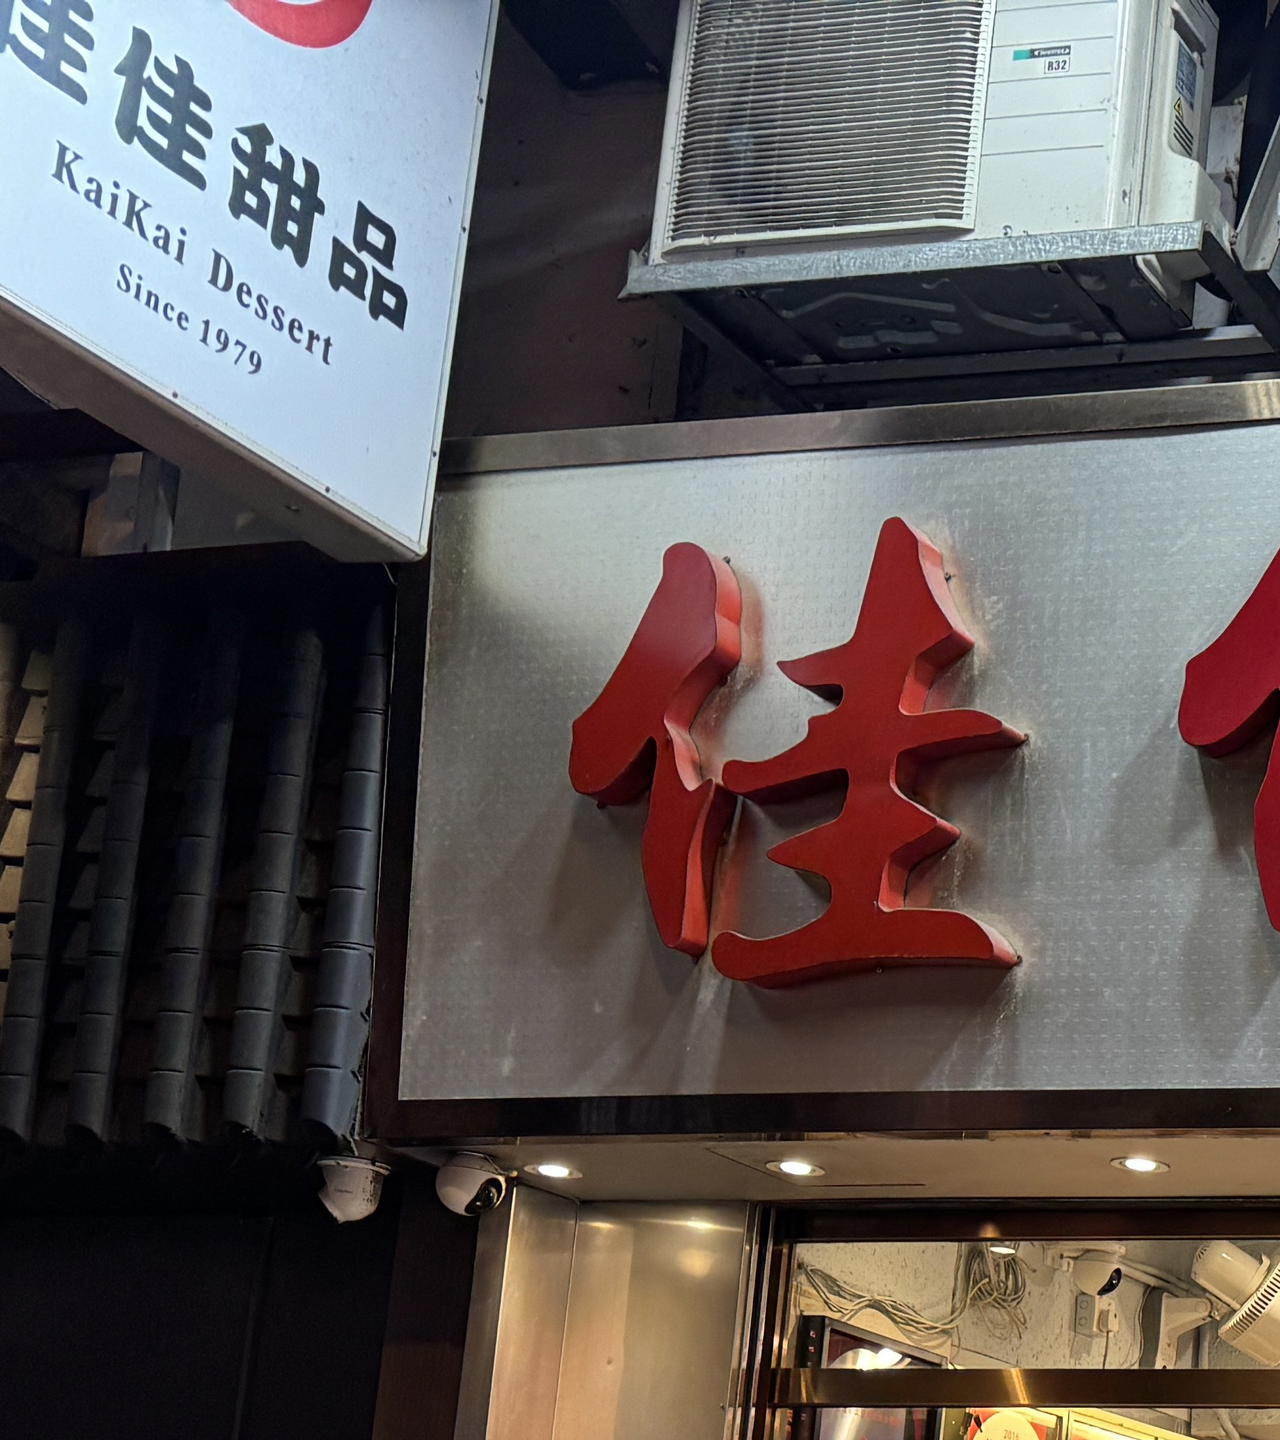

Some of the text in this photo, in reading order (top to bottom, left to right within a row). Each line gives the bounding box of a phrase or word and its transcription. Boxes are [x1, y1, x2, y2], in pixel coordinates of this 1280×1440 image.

[1047, 60, 1067, 71] R32
[51, 139, 336, 366] KaiKai Dessert
[116, 264, 263, 375] Since 1979
